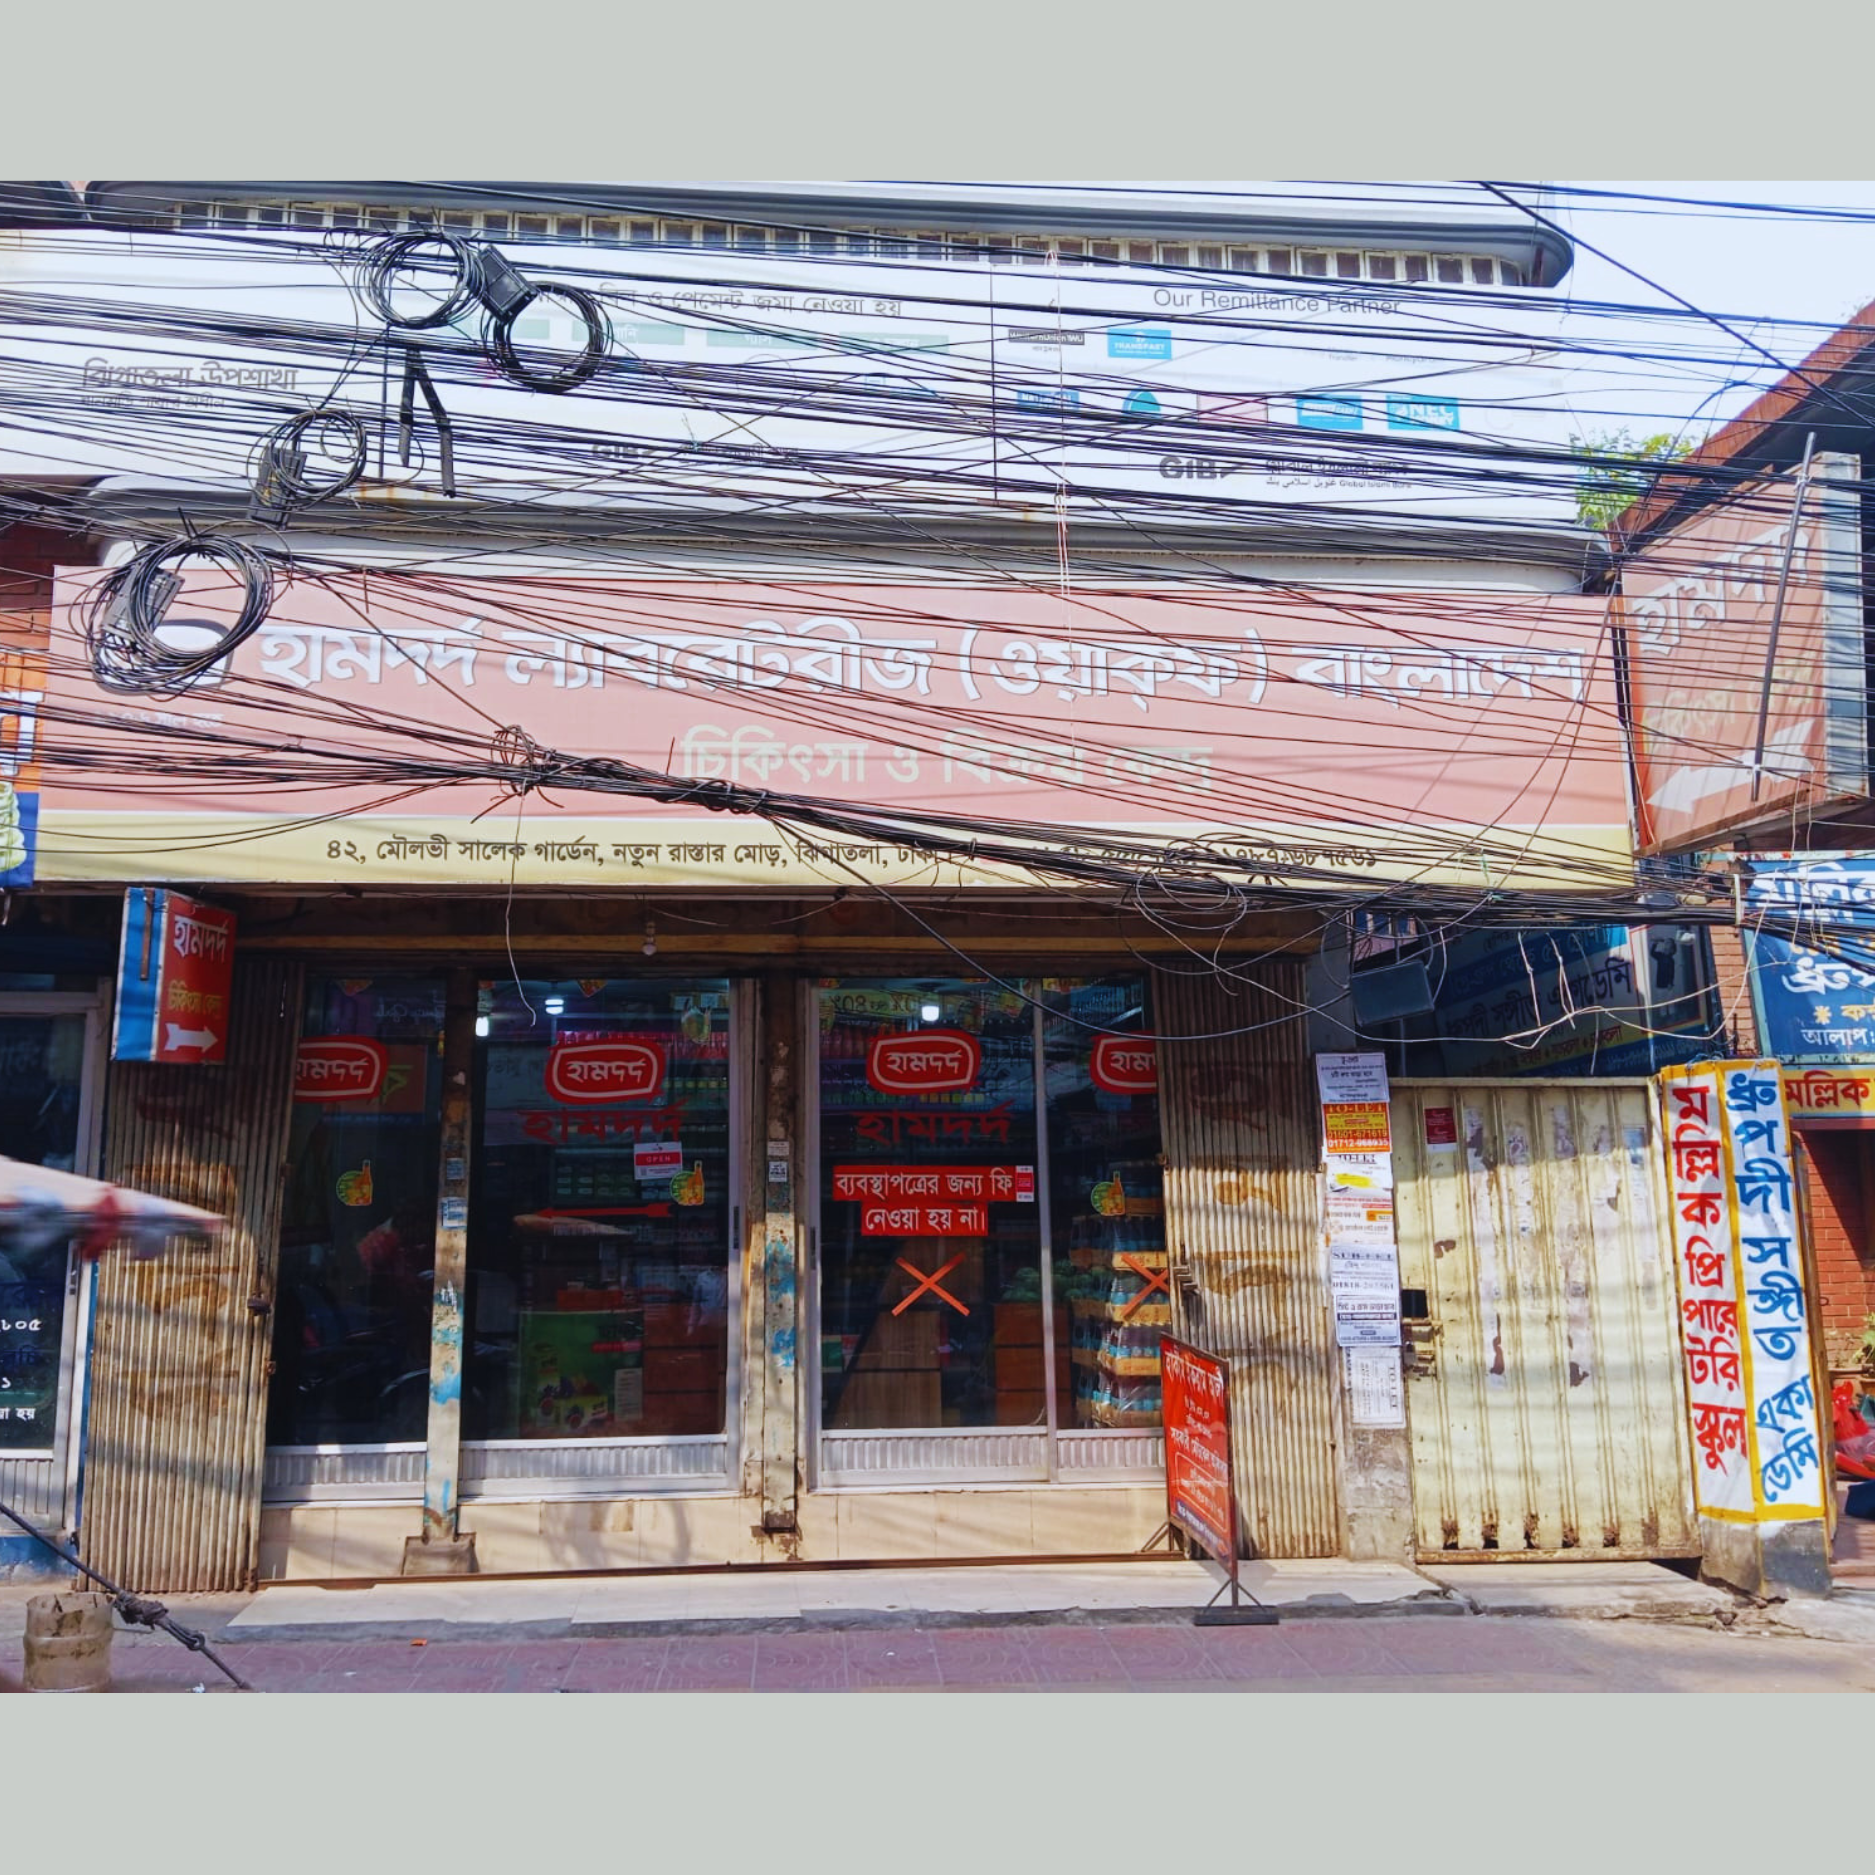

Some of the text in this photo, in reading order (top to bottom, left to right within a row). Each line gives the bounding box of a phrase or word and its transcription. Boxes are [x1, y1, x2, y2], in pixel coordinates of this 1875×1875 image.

[673, 289, 744, 310] পেমেন্ট
[754, 296, 795, 314] জমা
[872, 299, 903, 317] হয়
[1154, 288, 1401, 315] Our Remittance Partner
[200, 360, 299, 390] উপশাখা
[258, 616, 489, 690] হামদর্দ
[1291, 645, 1588, 711] বাংলাদেশ
[680, 724, 871, 784] চিকিৎসা
[885, 744, 921, 783] ও
[326, 839, 367, 865] ৪২,
[376, 834, 451, 861] মৌলভী
[457, 839, 528, 862] সালেক
[534, 835, 604, 867] গার্ডেন,
[611, 841, 662, 868] নতুন
[667, 841, 727, 864] রাস্তার
[733, 842, 787, 868] মোড়,
[172, 914, 229, 964] হামদর্দ
[565, 1057, 647, 1083] হামদর্দ
[884, 1049, 963, 1074] হামদর্দ
[1784, 1069, 1871, 1109] মল্লিক
[518, 1099, 688, 1145] হামদর্দ
[854, 1098, 1016, 1146] হামদর্দ
[646, 1154, 671, 1164] OPEN
[836, 1167, 1015, 1200] ব্যবস্থাপত্রের জন্য ফি
[864, 1207, 921, 1232] নেওয়া
[926, 1208, 952, 1232] হয়
